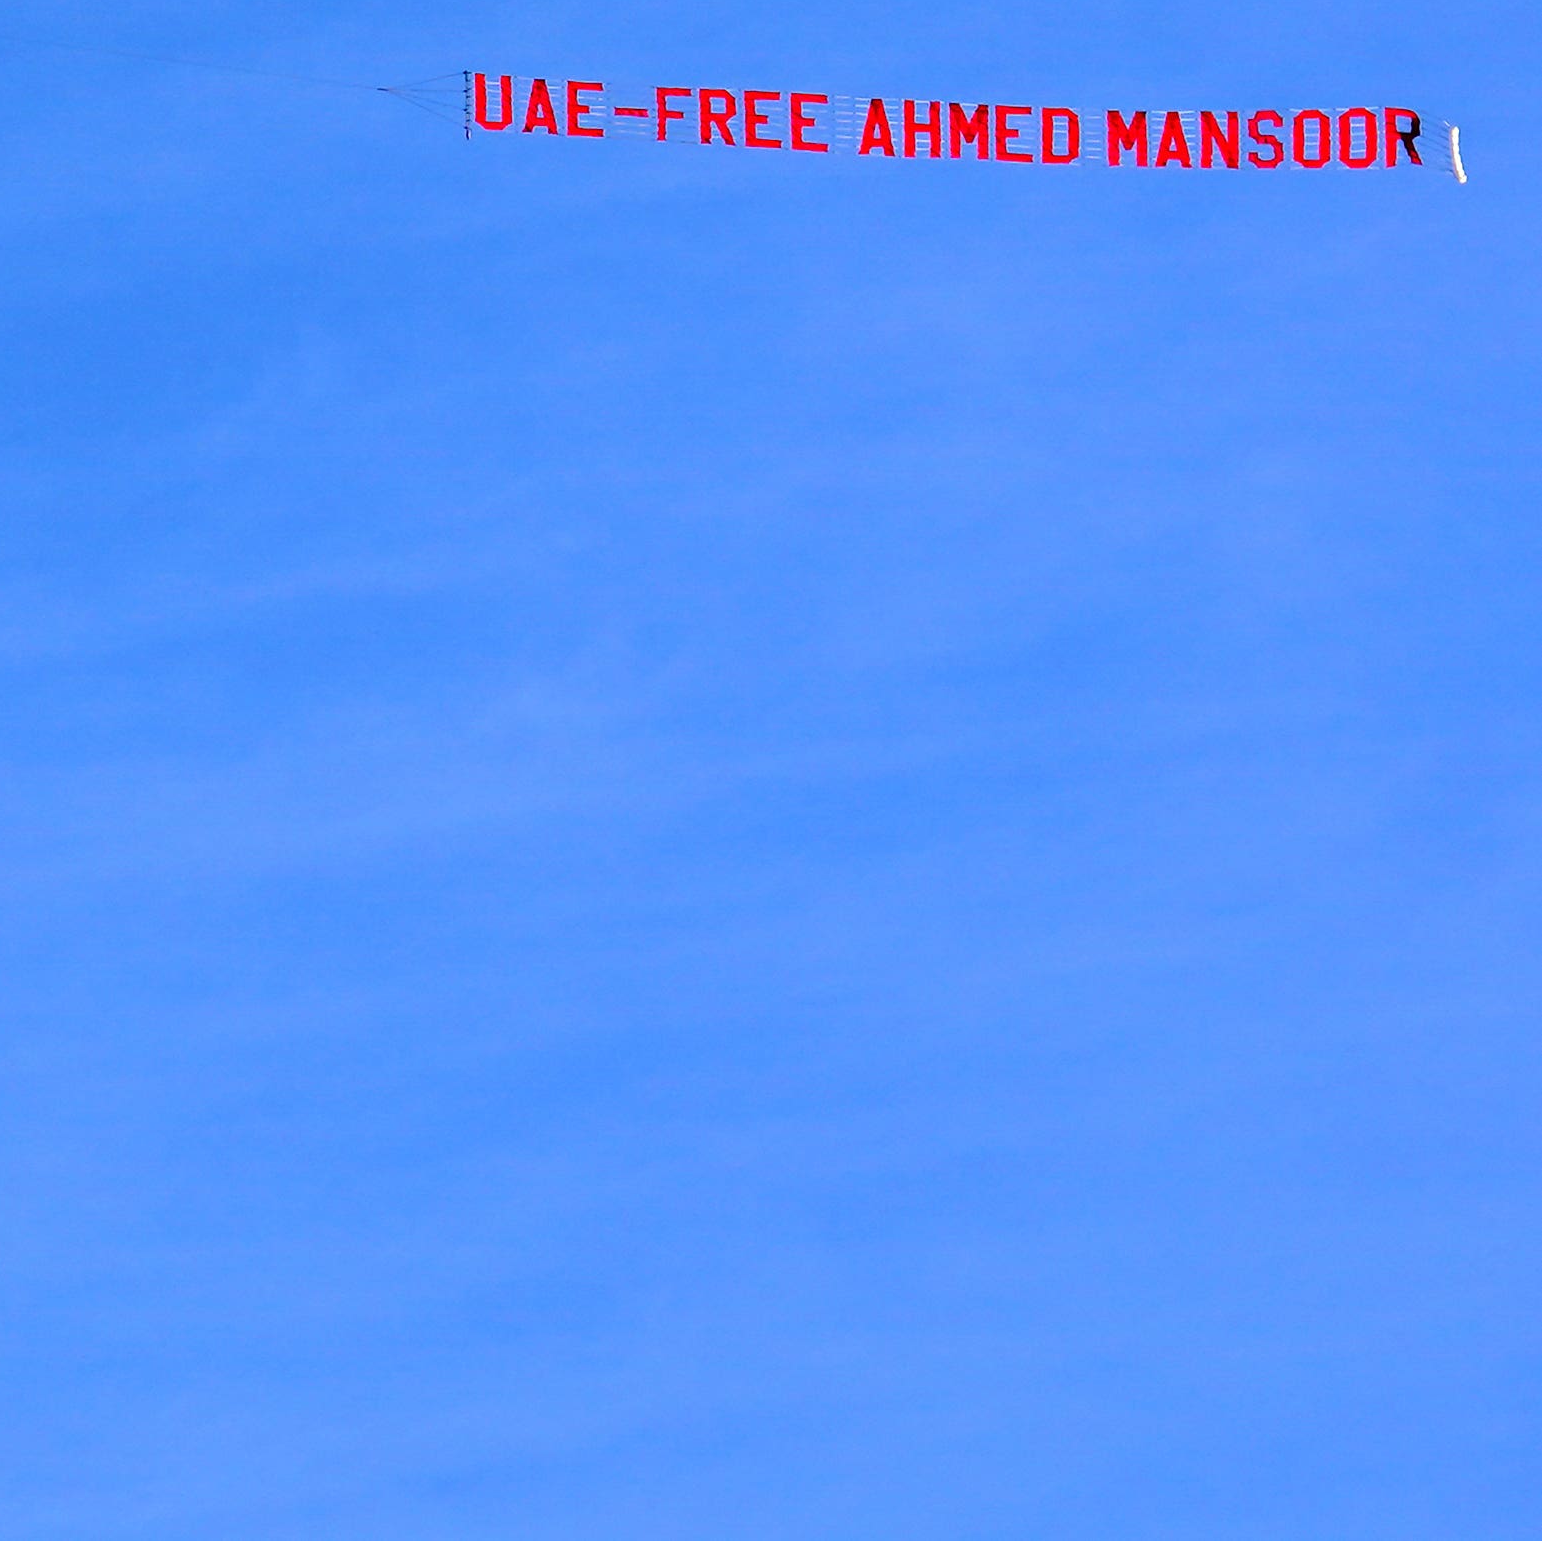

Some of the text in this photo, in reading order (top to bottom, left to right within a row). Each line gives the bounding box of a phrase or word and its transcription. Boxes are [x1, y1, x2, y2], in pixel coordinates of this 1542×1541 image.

[474, 73, 1423, 169] UAE-FREE AHMED MANSOOR
